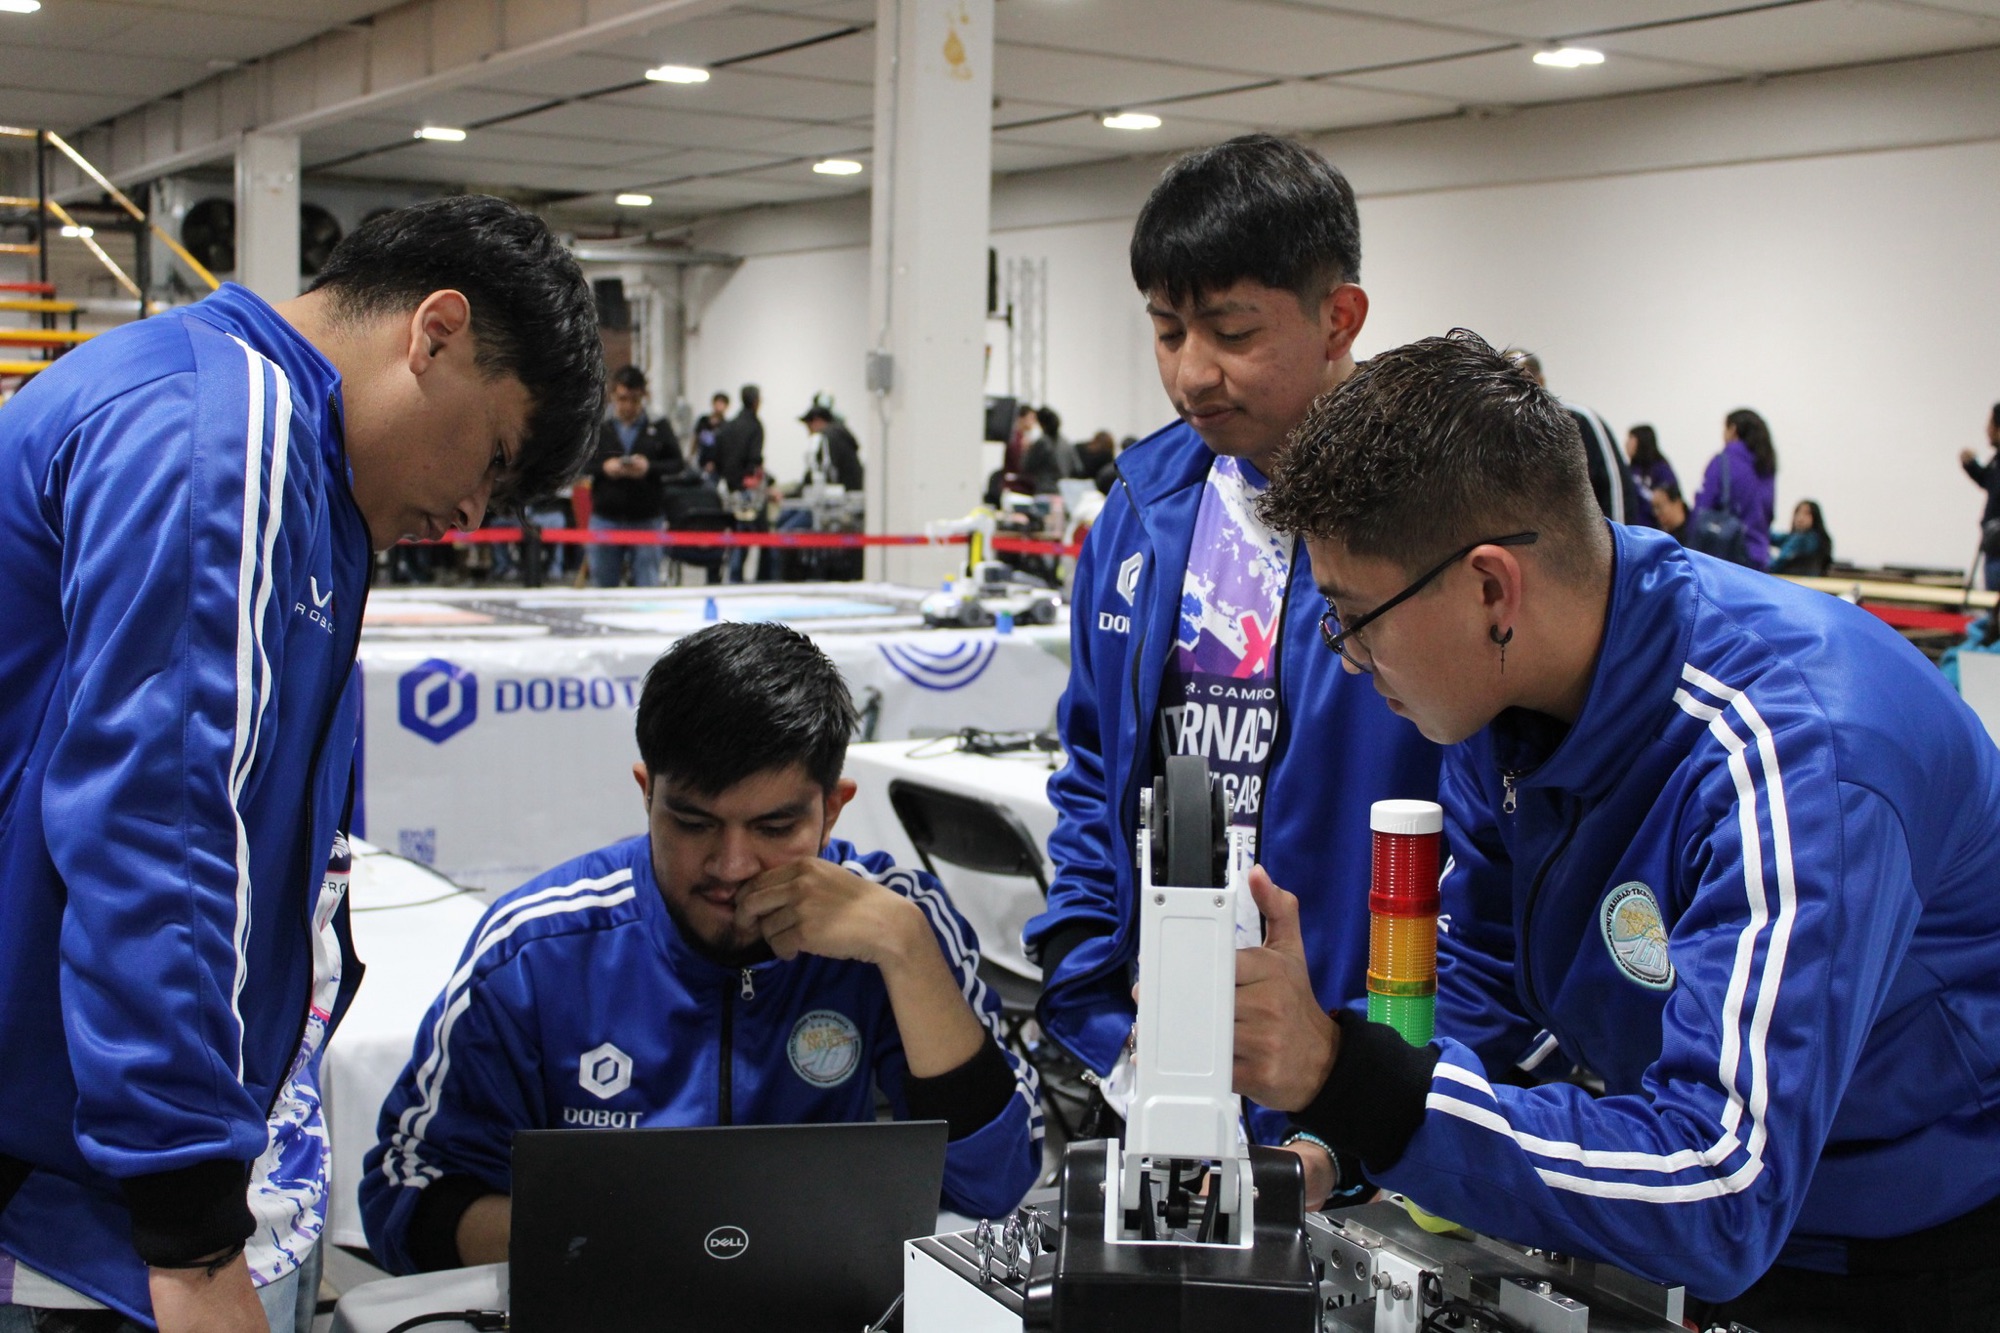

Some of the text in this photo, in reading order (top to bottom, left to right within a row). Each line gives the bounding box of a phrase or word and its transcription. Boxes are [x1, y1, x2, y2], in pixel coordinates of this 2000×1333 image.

[294, 602, 336, 635] ROBO
[495, 675, 640, 714] DOBOT
[563, 1106, 643, 1129] DOBOT
[710, 1237, 744, 1248] DELL
